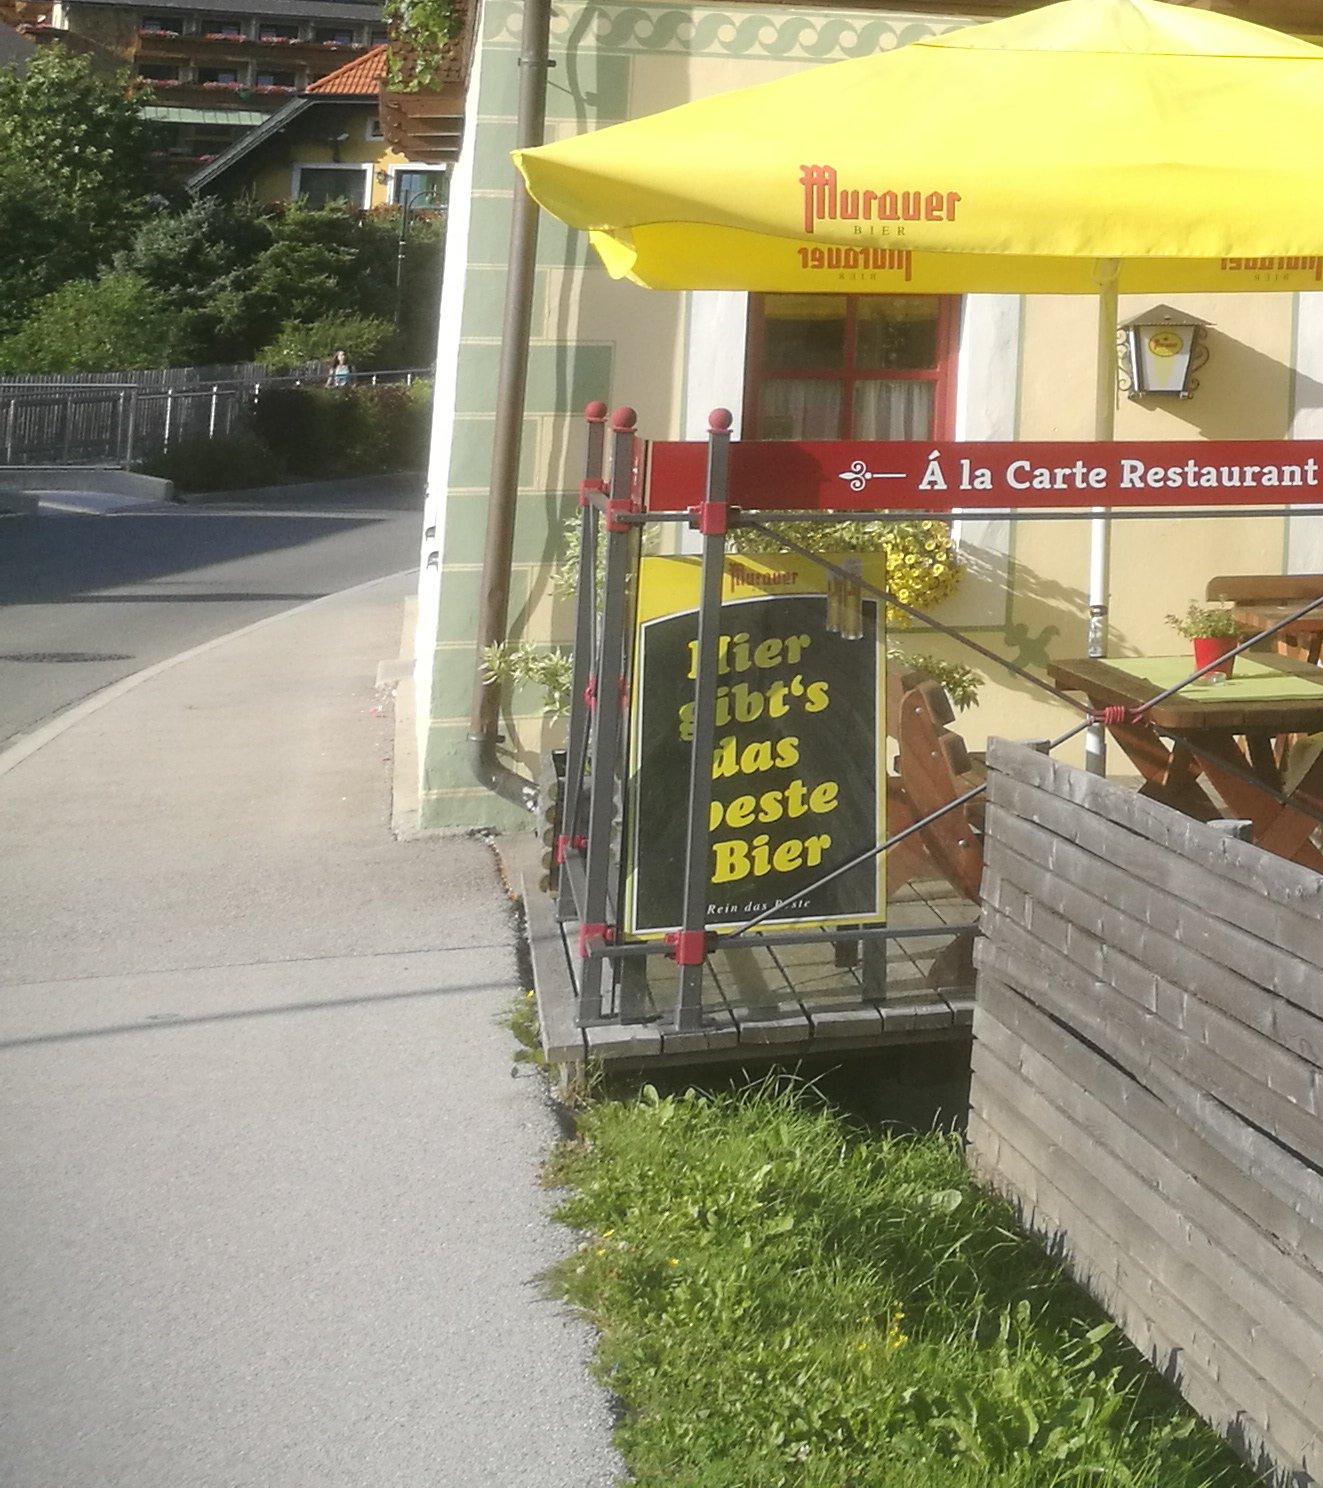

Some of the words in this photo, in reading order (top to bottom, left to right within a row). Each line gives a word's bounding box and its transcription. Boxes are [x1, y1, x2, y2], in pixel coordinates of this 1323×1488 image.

[799, 164, 962, 234] Murauer
[853, 225, 906, 236] BIER
[918, 449, 948, 491] Á
[959, 458, 993, 491] la
[1006, 459, 1107, 491] Carte
[1120, 457, 1319, 489] Restaurant
[711, 735, 800, 780] das
[711, 833, 832, 884] Bier
[706, 903, 739, 915] Rein
[743, 900, 768, 912] das
